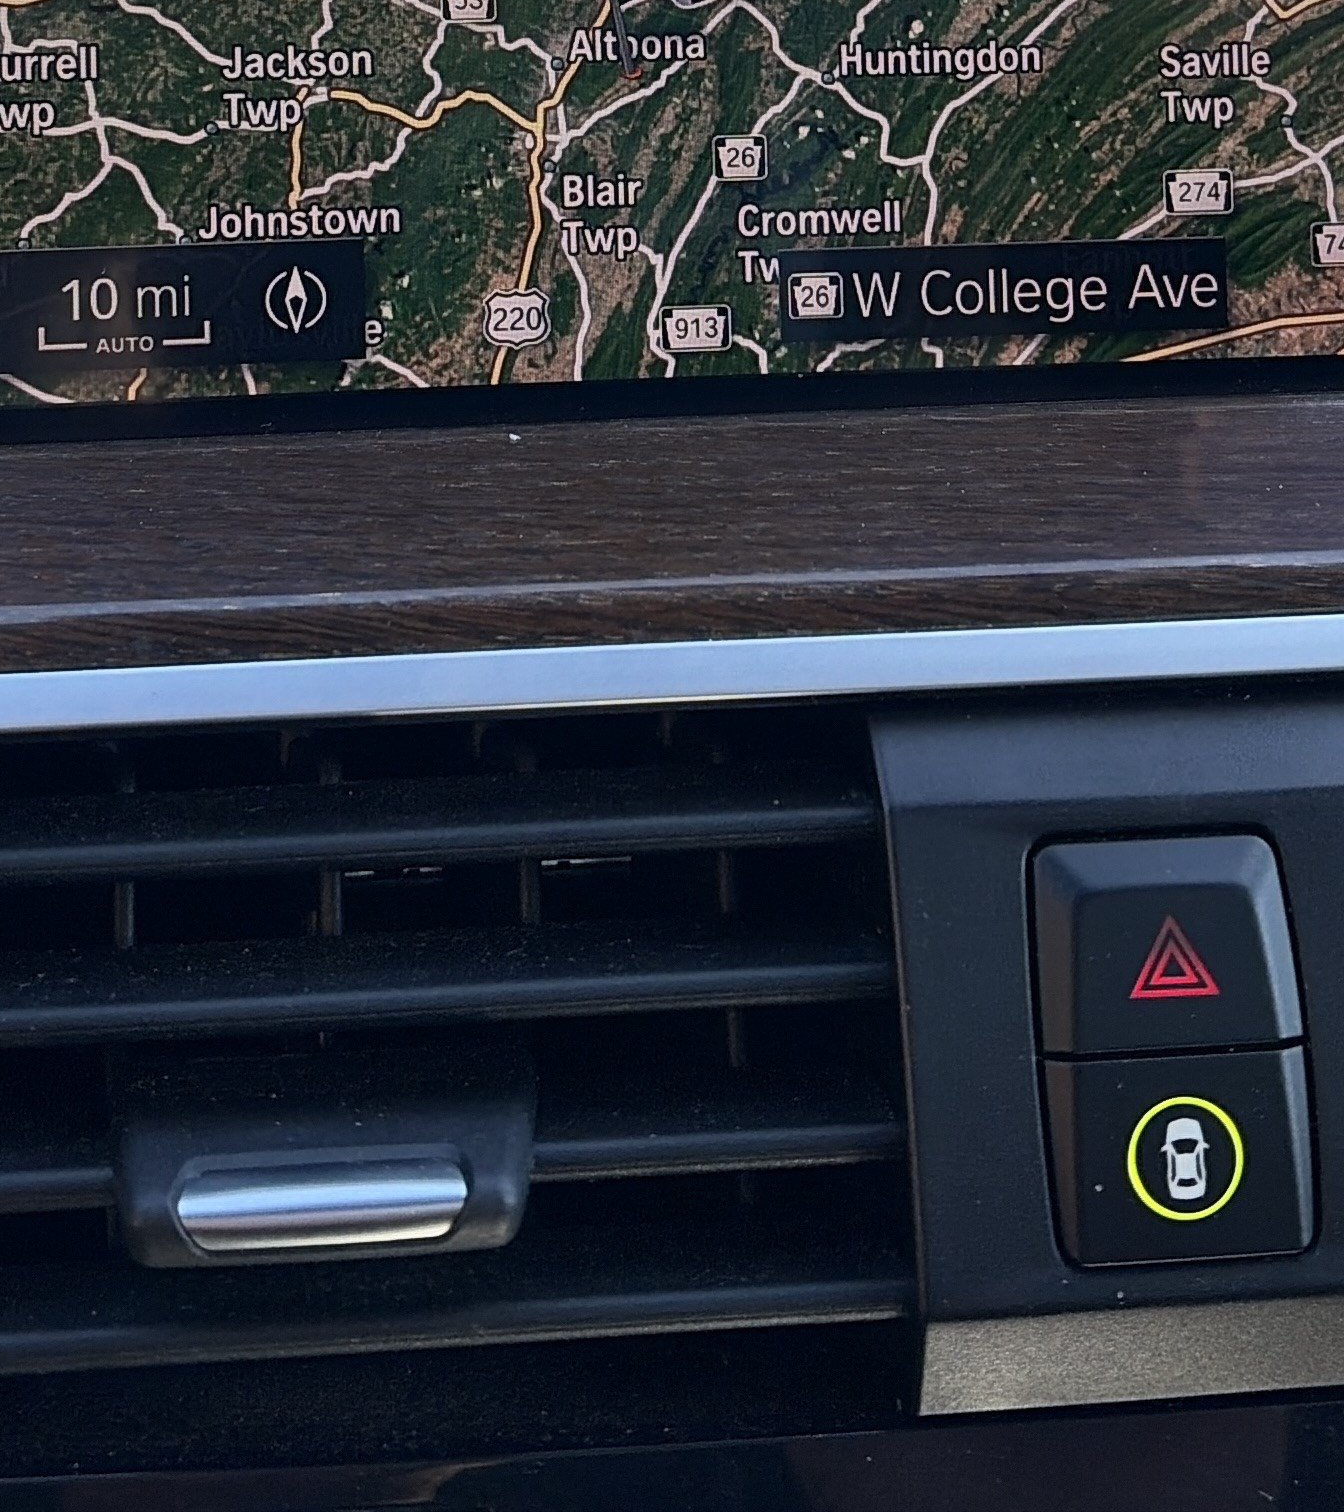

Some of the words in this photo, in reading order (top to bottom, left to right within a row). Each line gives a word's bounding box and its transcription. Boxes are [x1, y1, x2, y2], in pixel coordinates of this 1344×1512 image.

[223, 45, 372, 79] Jackson
[840, 44, 1042, 79] Huntingdon
[1161, 46, 1269, 78] Saville
[224, 94, 300, 130] Twp
[1161, 92, 1234, 126] Twp
[727, 148, 754, 168] 26
[563, 176, 642, 208] Blair
[1179, 184, 1219, 202] 274
[198, 205, 400, 242] Johnstown
[738, 202, 903, 237] Cromwell
[563, 223, 638, 262] Twp
[61, 279, 117, 320] 10
[137, 276, 192, 317] mi
[800, 286, 829, 308] 26
[853, 272, 900, 317] W
[922, 268, 1107, 323] College
[1128, 264, 1218, 309] Ave
[493, 307, 541, 332] 220
[674, 317, 717, 339] 913
[95, 335, 153, 353] AUTO
